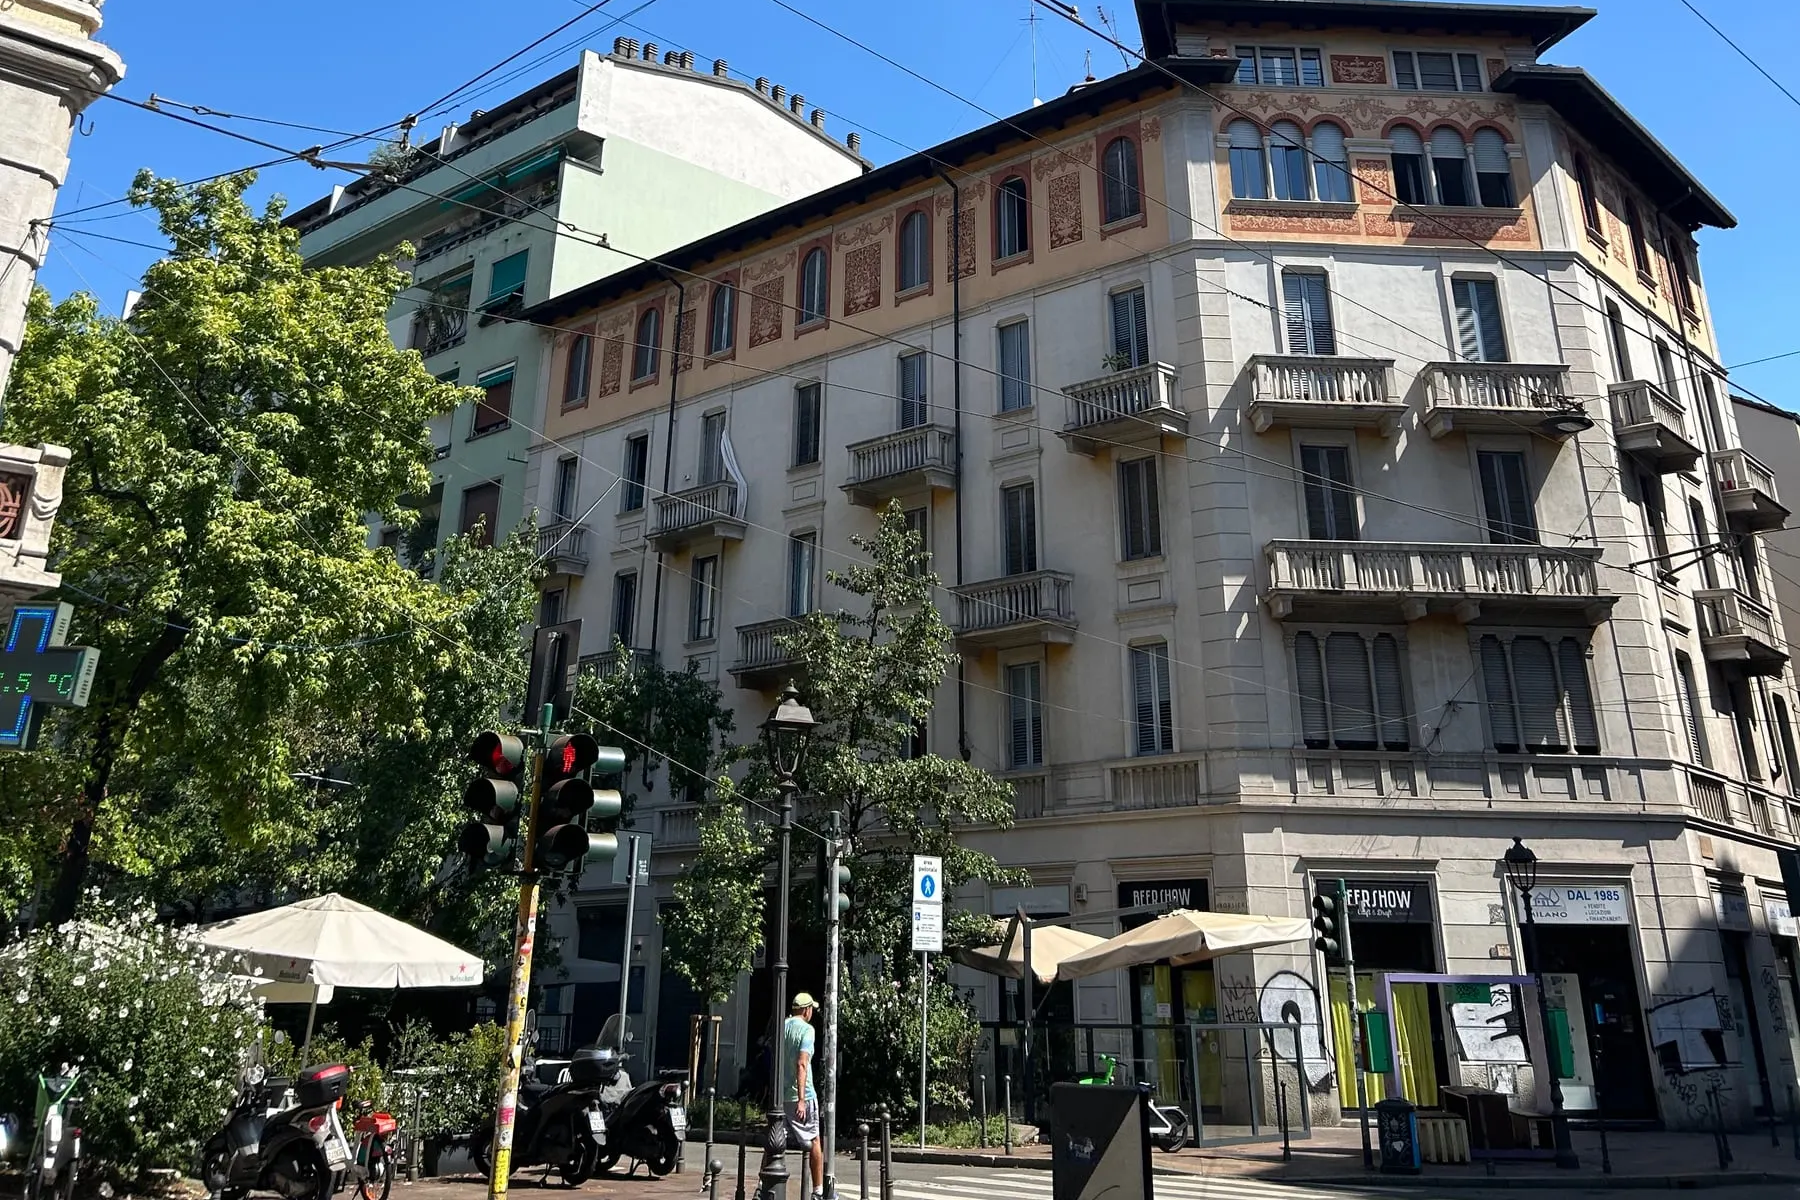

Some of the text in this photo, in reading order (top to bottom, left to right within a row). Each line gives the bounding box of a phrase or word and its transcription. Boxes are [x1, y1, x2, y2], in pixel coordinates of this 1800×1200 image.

[1346, 889, 1411, 909] EERSHOW
[1567, 890, 1620, 901] DAL 1985
